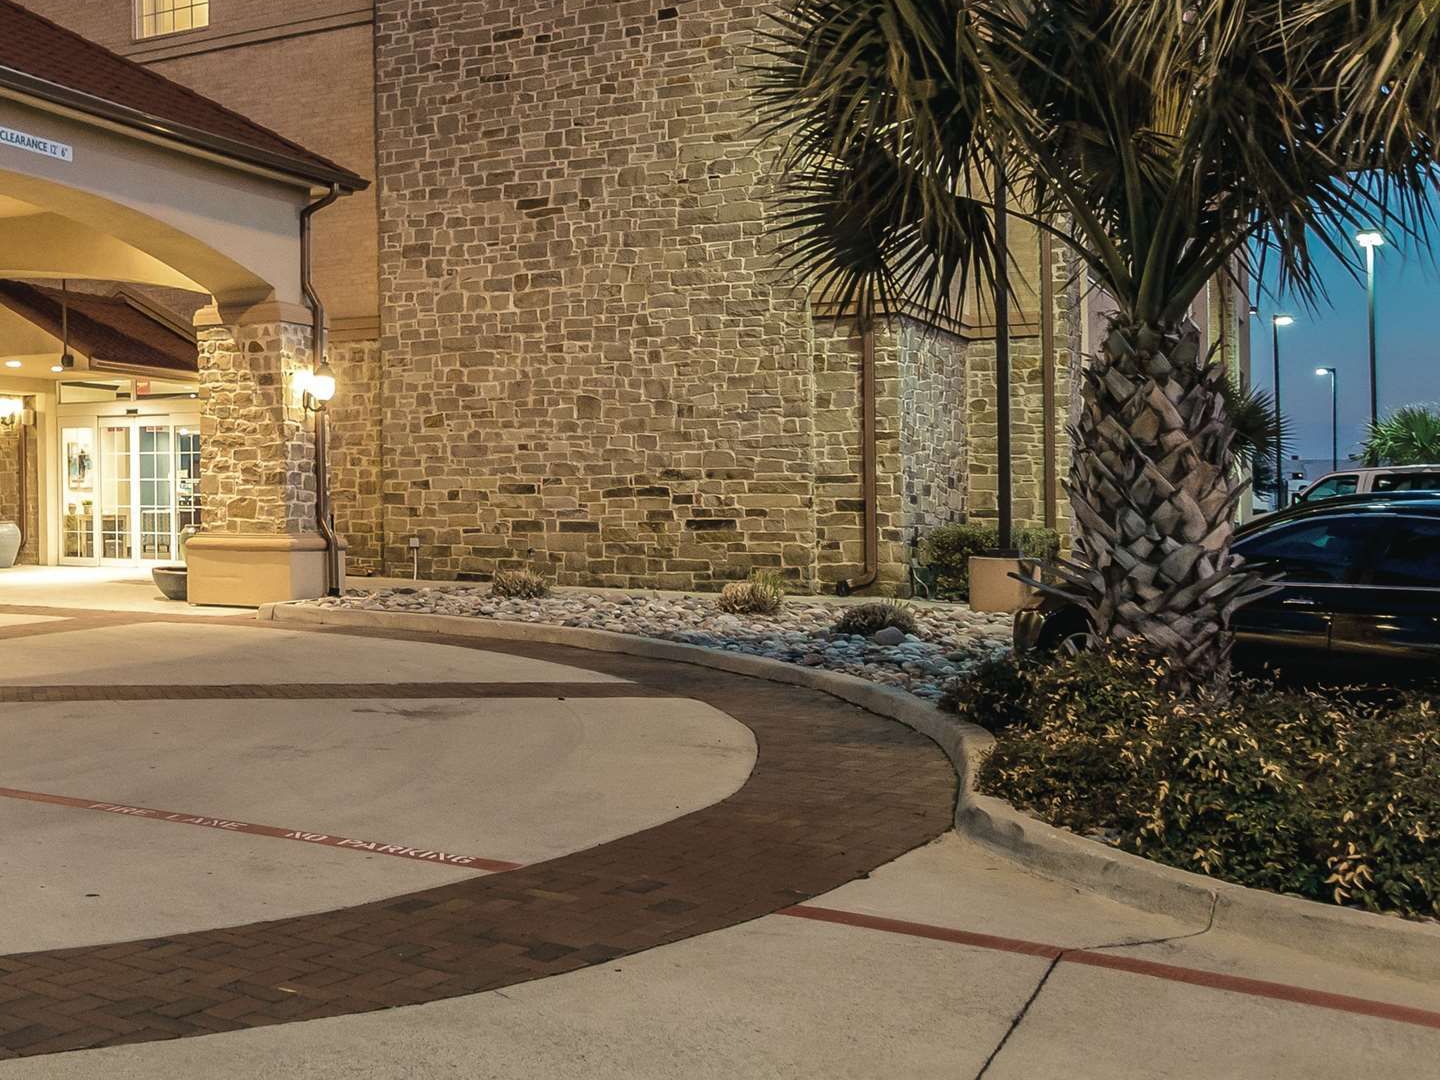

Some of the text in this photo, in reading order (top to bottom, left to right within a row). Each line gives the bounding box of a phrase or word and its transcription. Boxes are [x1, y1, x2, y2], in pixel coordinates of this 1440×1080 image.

[0, 130, 47, 152] CLEARANCE
[89, 802, 477, 864] FIRE LANE NO PARKING
